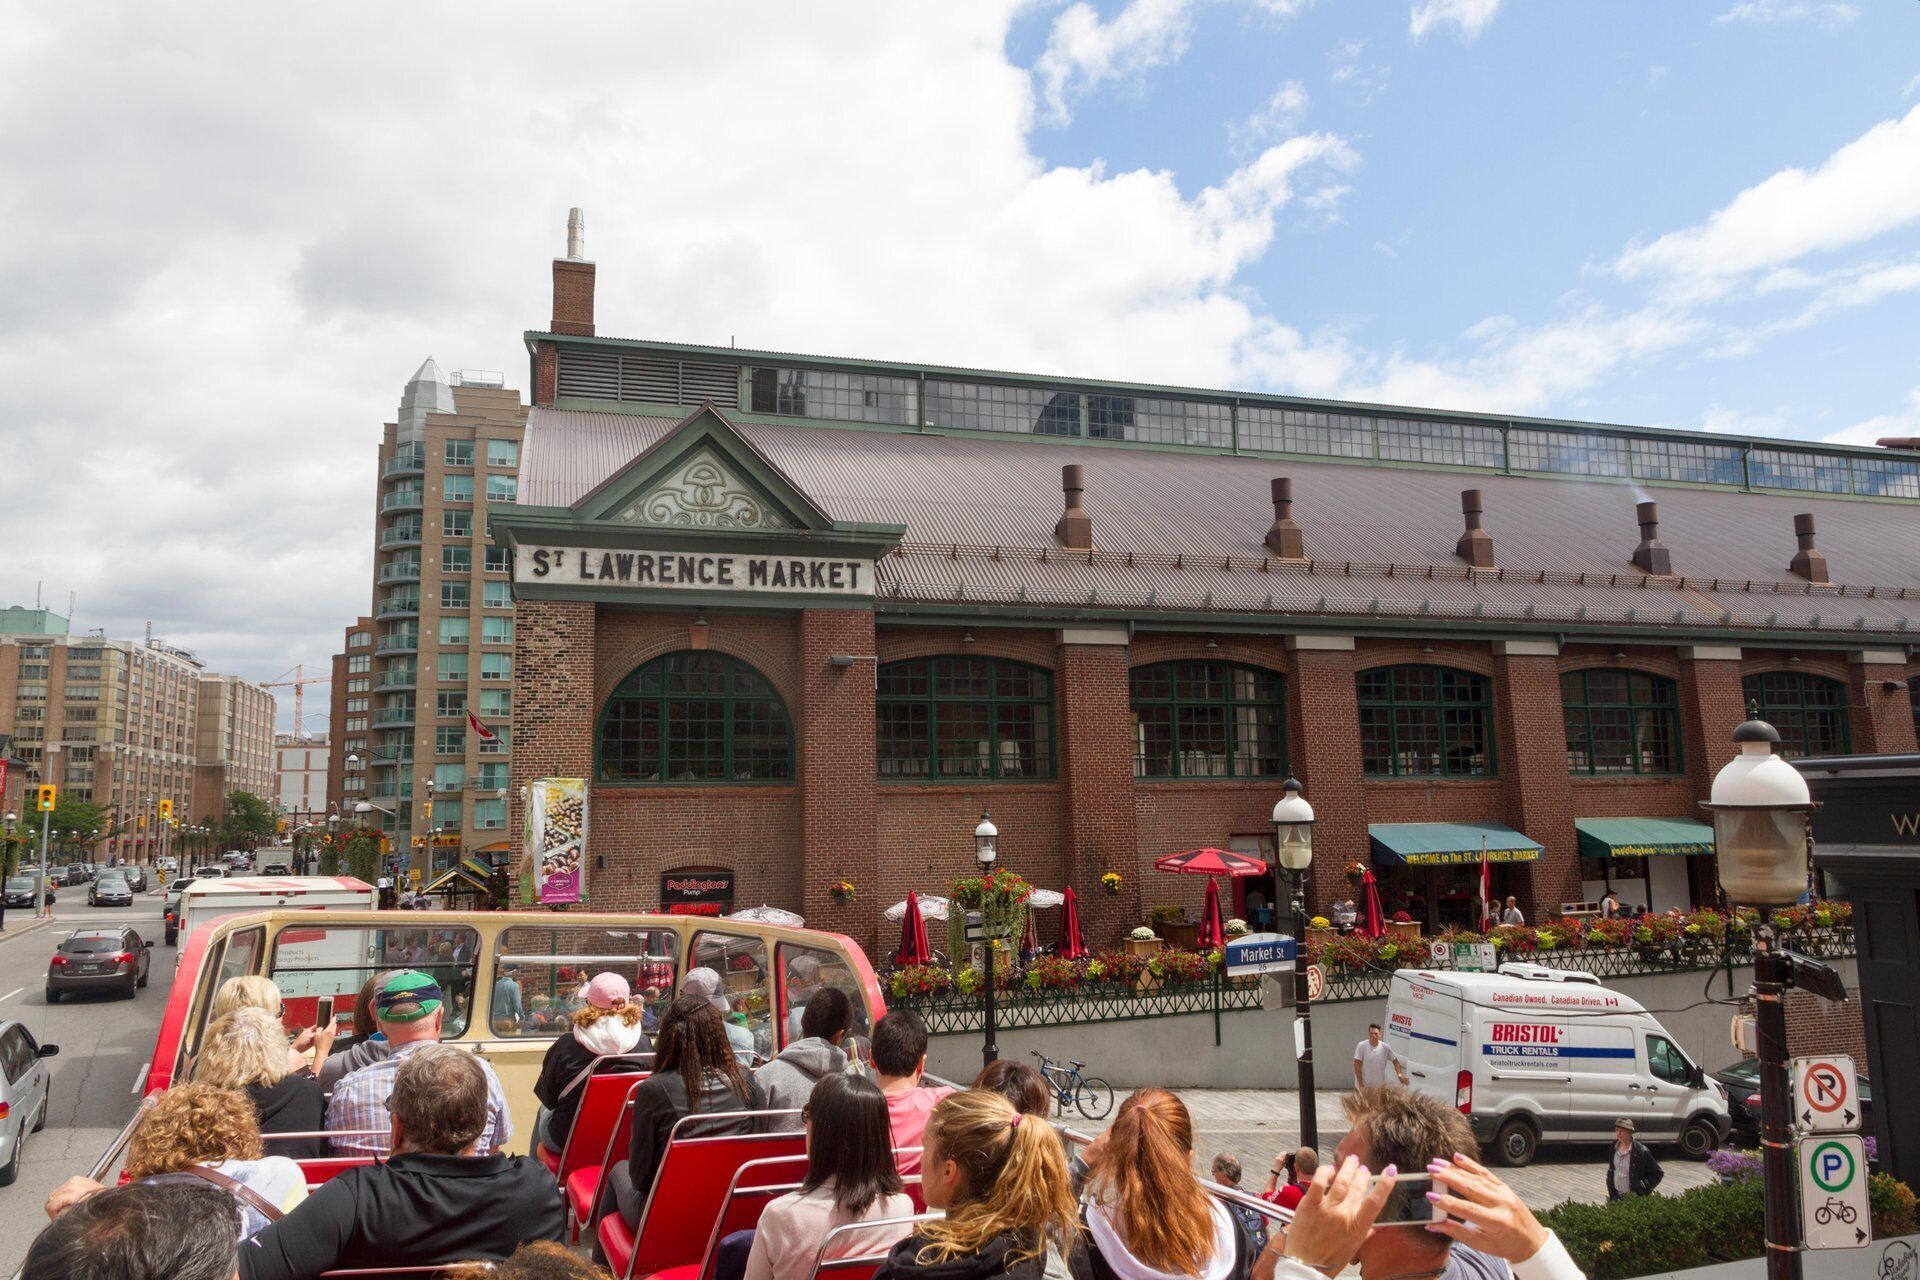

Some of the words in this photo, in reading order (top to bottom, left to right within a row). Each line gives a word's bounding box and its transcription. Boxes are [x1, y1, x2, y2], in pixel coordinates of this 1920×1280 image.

[580, 551, 734, 585] LAWRENCE
[749, 559, 861, 589] MARKET
[1405, 853, 1440, 864] WELCOME
[1441, 853, 1449, 863] to
[1450, 852, 1461, 862] The
[1463, 852, 1474, 862] ST.
[1512, 850, 1539, 860] MARKET
[666, 878, 729, 891] Paddington's
[1240, 946, 1273, 963] Market
[1276, 947, 1285, 959] St
[1258, 963, 1267, 971] 26
[1492, 992, 1523, 1003] Canadian
[1524, 994, 1548, 1004] Owned.
[1551, 995, 1580, 1005] Canadian
[1581, 996, 1602, 1006] Driven.
[1491, 1024, 1559, 1043] BRISTOL
[1490, 1045, 1520, 1055] TRUCK
[1521, 1046, 1559, 1057] RENTALS
[1490, 1059, 1559, 1068] bristoltruckrentals.com
[1822, 1153, 1842, 1182] P
